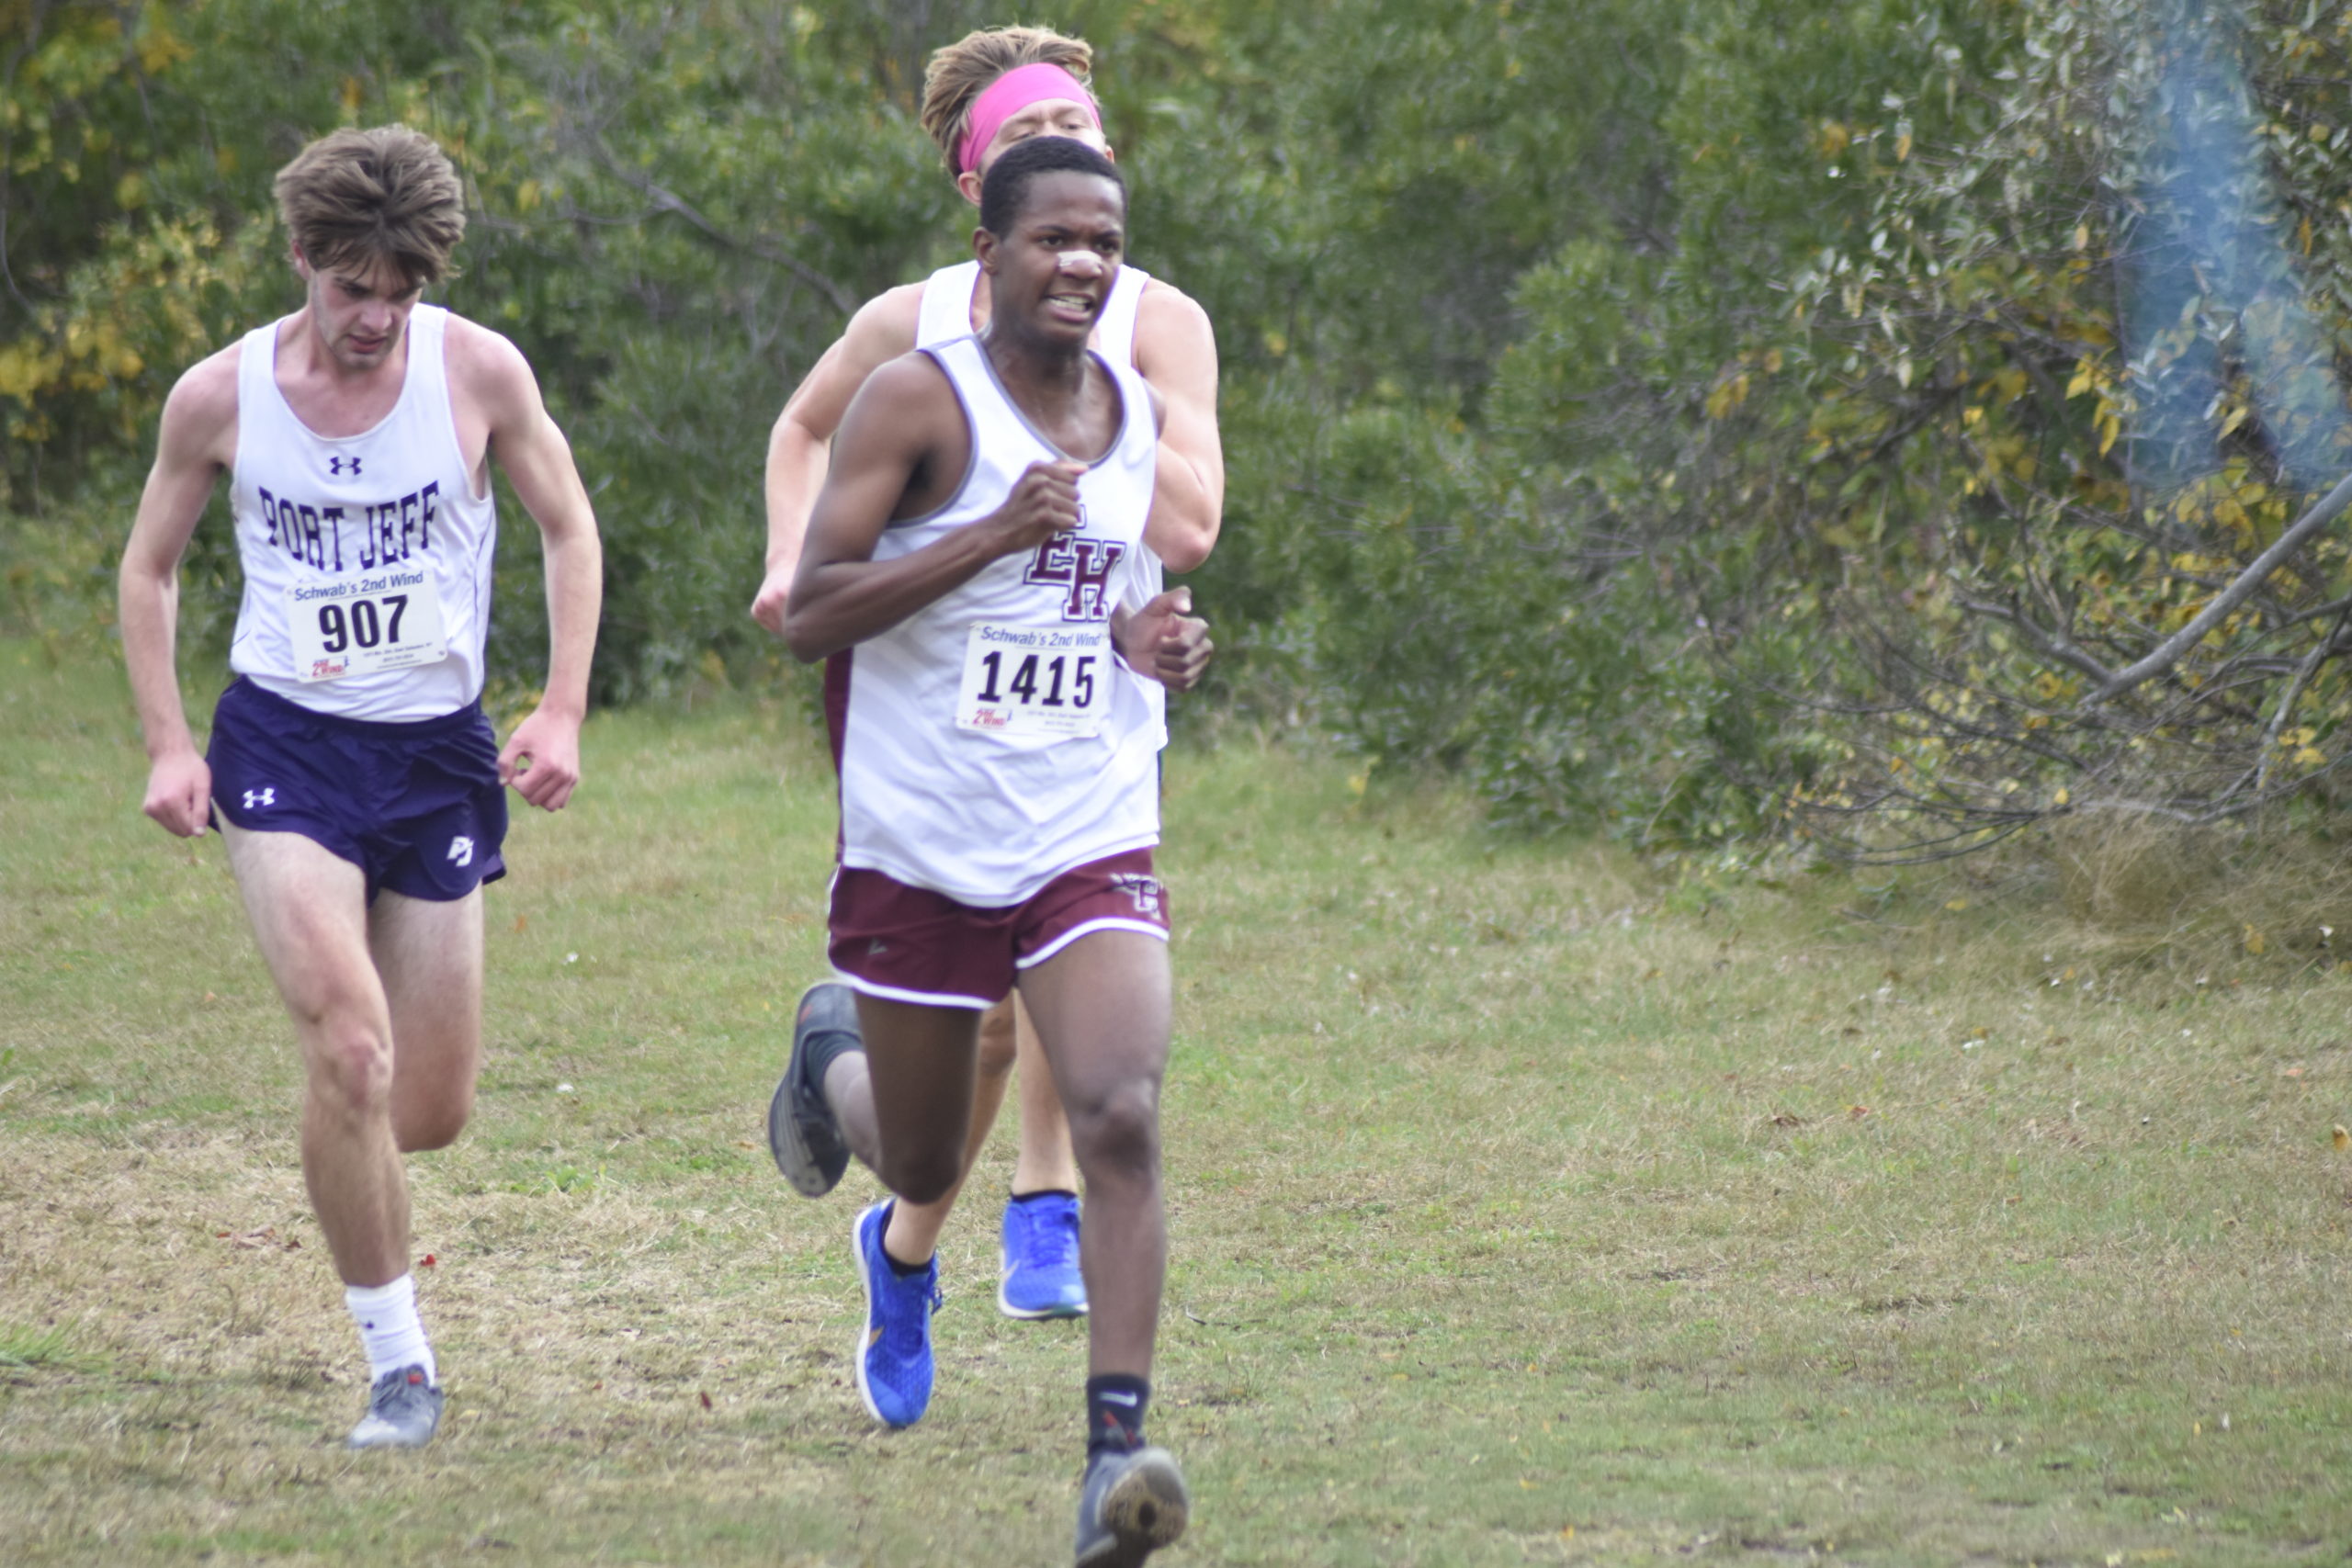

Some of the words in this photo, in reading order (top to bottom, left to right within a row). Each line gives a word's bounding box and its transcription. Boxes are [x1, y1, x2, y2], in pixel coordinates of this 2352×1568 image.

[258, 486, 345, 571] PORT
[359, 480, 438, 570] JEFF
[295, 581, 357, 601] Schwab's
[361, 577, 386, 592] 2nd
[390, 570, 424, 588] Wind
[1023, 531, 1126, 622] EH
[319, 594, 408, 653] 907
[981, 626, 1046, 646] Schwab's
[1049, 633, 1073, 647] 2nd
[1076, 633, 1102, 647] Wind
[978, 651, 1096, 708] 1415
